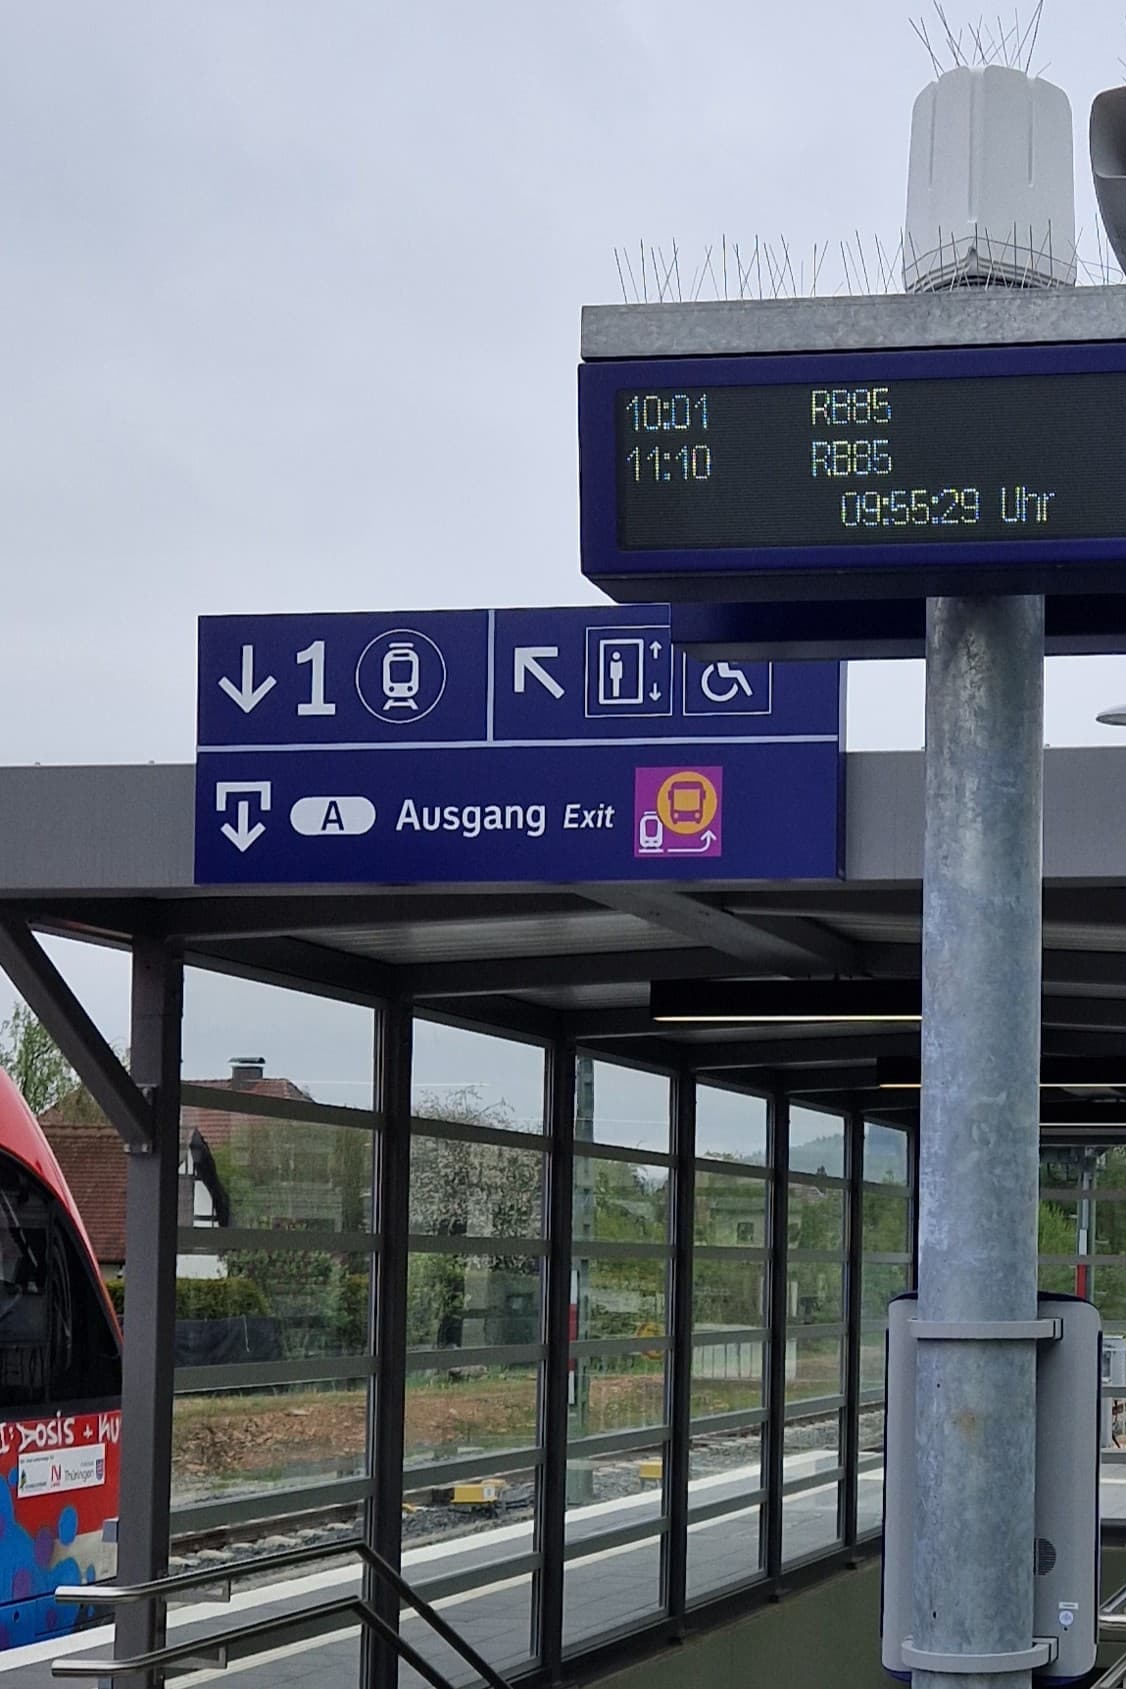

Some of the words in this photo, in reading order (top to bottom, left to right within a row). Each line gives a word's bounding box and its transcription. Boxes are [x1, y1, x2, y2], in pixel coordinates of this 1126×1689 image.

[625, 393, 708, 431] 10:01
[811, 387, 892, 426] RB85
[626, 445, 711, 481] 11:10
[811, 439, 892, 477] RB85
[841, 488, 980, 527] 09:55:29
[1001, 486, 1055, 523] Uhr
[296, 640, 336, 716] 1
[320, 800, 345, 832] A
[395, 799, 547, 838] Ausgang
[563, 803, 616, 830] Exit
